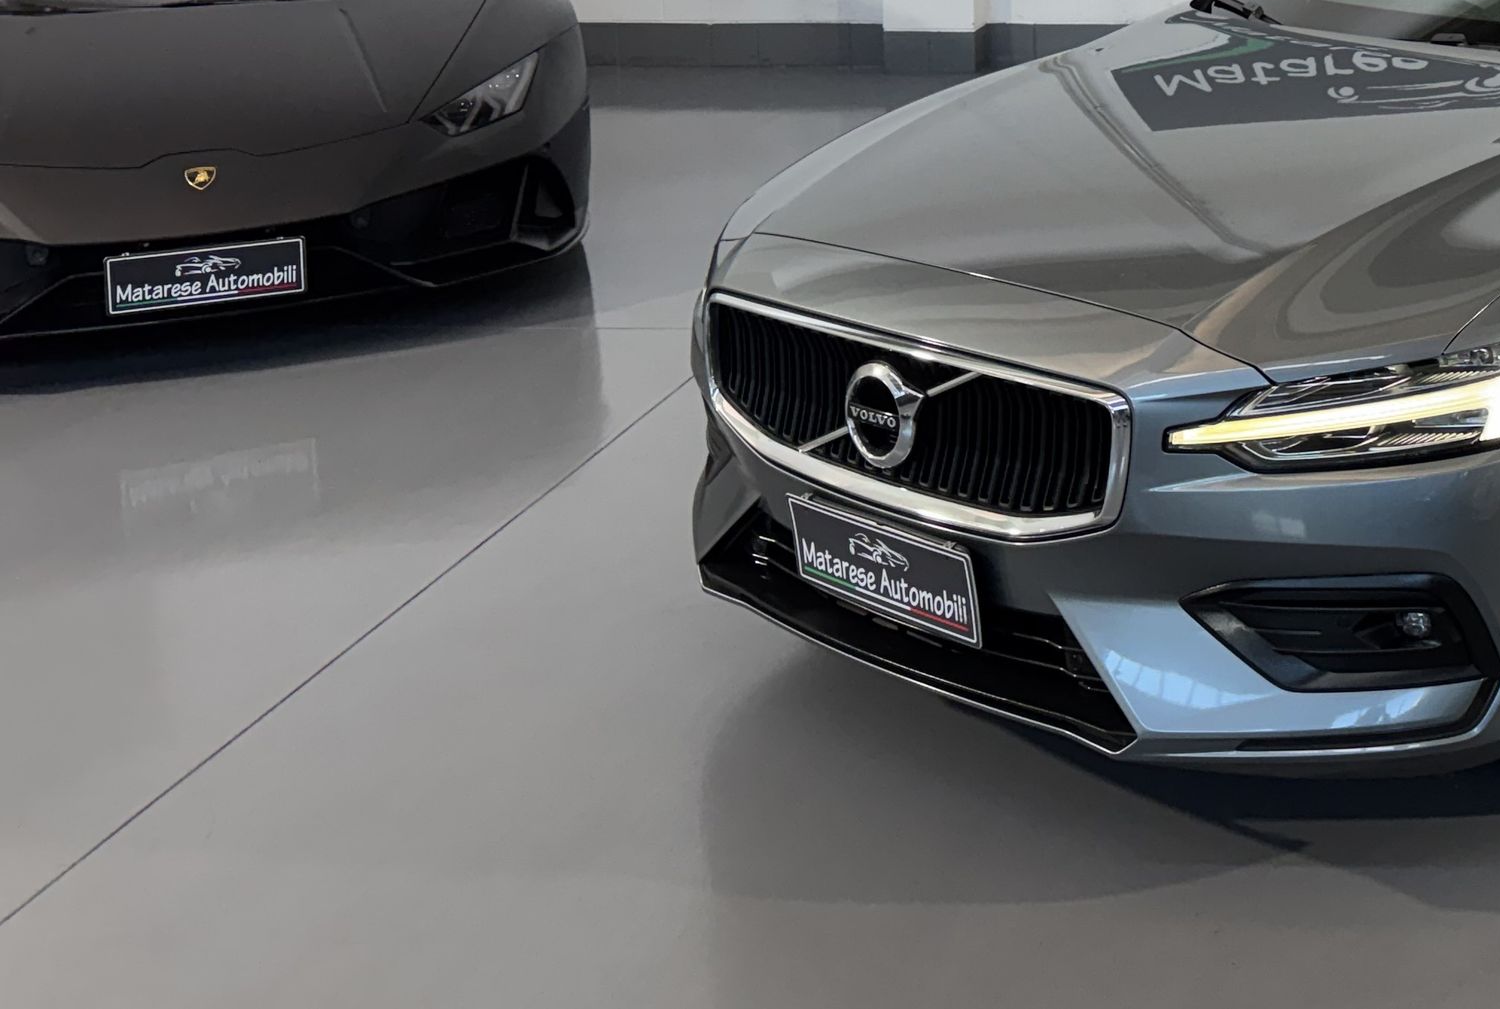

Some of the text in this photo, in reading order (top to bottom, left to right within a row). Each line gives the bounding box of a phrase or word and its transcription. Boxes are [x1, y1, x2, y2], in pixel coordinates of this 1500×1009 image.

[115, 265, 297, 303] Matarese Automobili
[849, 405, 897, 428] VOLVO
[802, 538, 968, 624] Matarese Automobili
